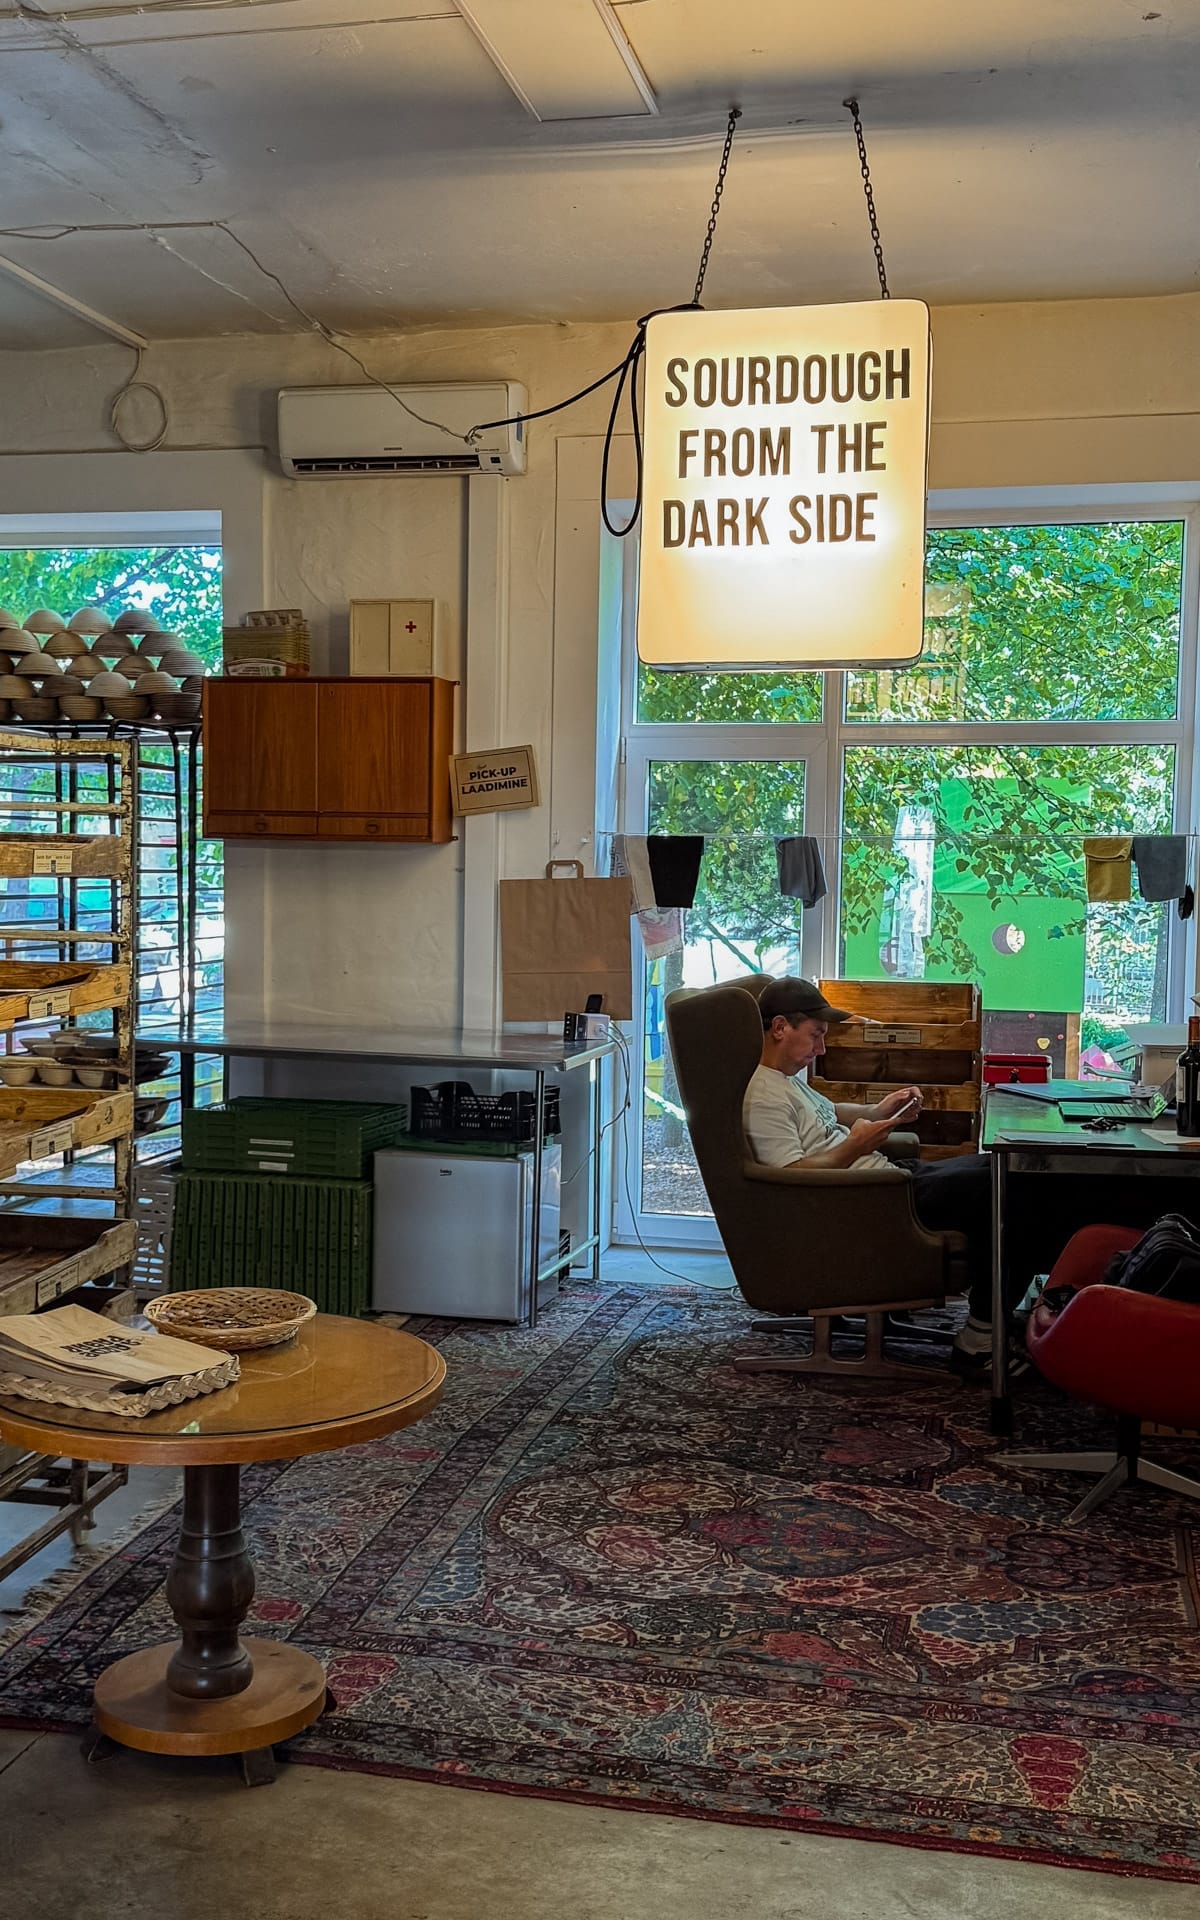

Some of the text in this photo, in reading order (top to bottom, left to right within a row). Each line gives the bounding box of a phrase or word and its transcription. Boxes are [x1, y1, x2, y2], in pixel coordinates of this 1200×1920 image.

[665, 348, 910, 407] SOURDOUGH
[678, 421, 887, 478] FROM THE
[663, 492, 878, 548] DARK SIDE
[461, 778, 528, 795] LAADIMINE
[469, 767, 517, 780] PICK-UP
